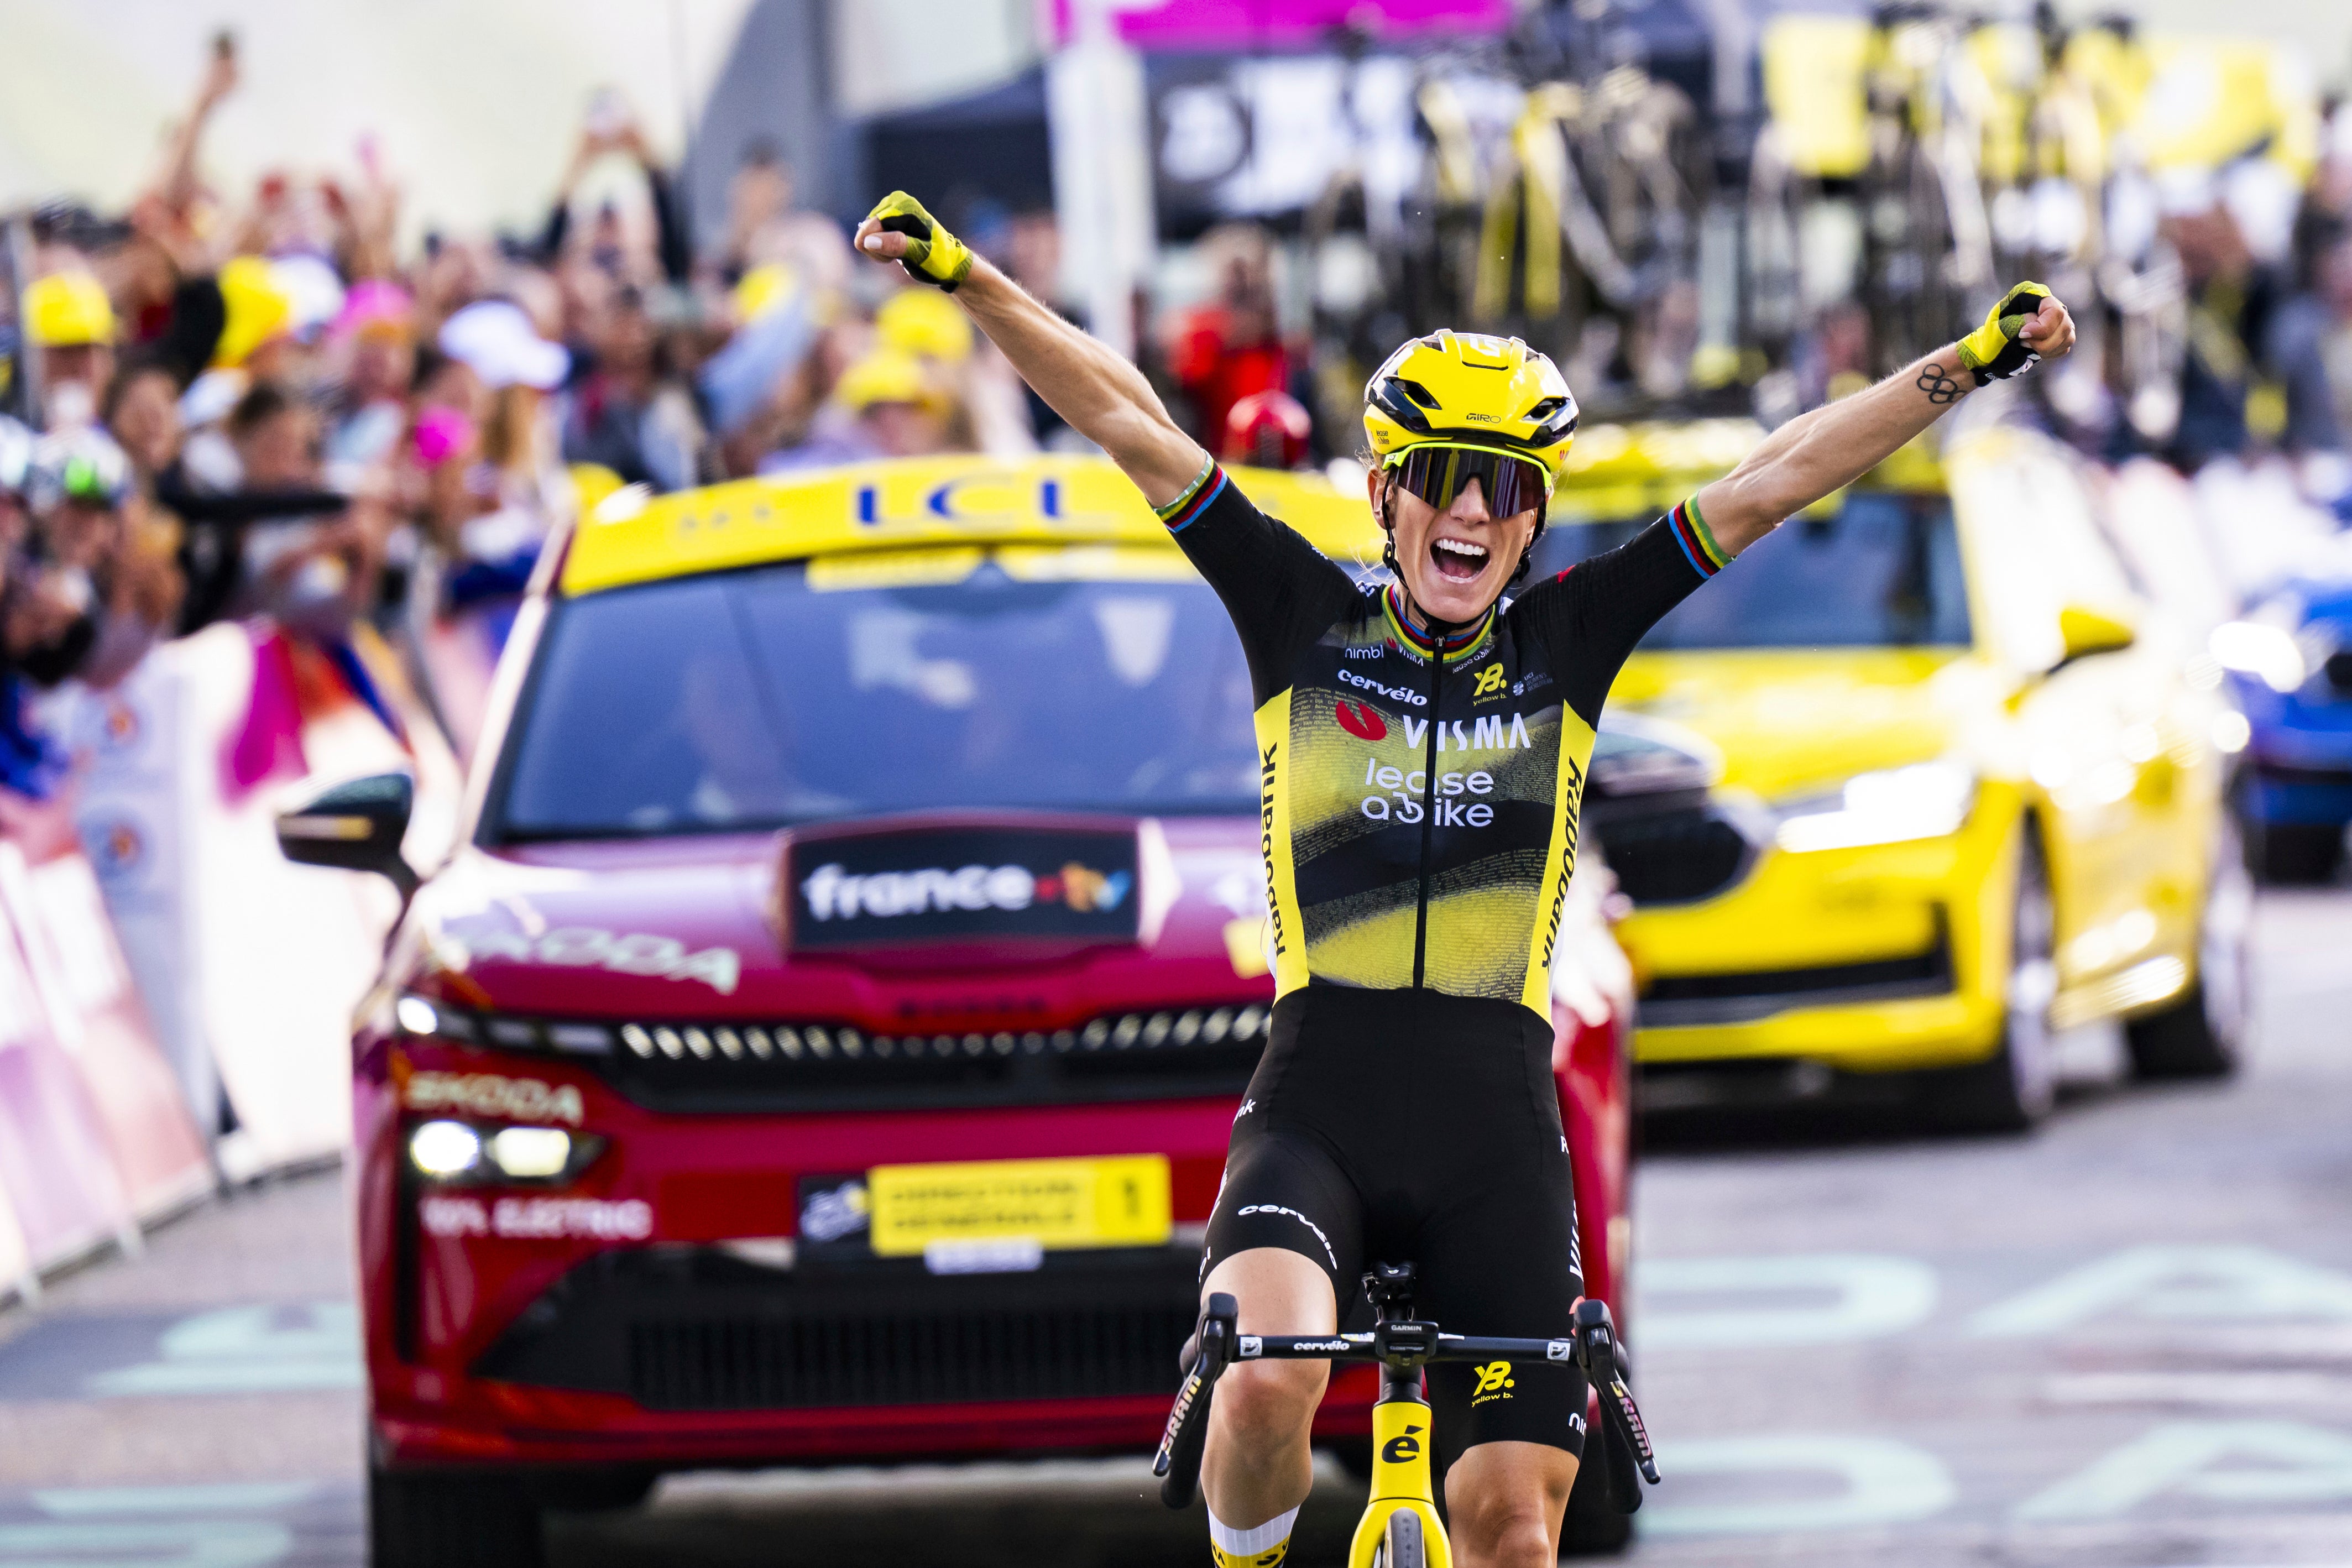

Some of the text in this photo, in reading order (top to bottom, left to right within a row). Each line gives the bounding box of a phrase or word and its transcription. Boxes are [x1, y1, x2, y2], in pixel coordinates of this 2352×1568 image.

[1466, 412, 1501, 424] GIRO
[853, 479, 1120, 534] LCL
[1345, 644, 1384, 659] nimbl
[1337, 669, 1428, 706] cervélo
[1473, 695, 1499, 707] yellow
[1403, 712, 1532, 752] VISMA
[1364, 757, 1494, 795] lease
[1237, 1204, 1337, 1270] cervélo
[1293, 1340, 1350, 1351] cervélo
[1160, 1374, 1202, 1456] SRAM
[1472, 1394, 1501, 1408] yellow
[1609, 1380, 1652, 1457] SRAM
